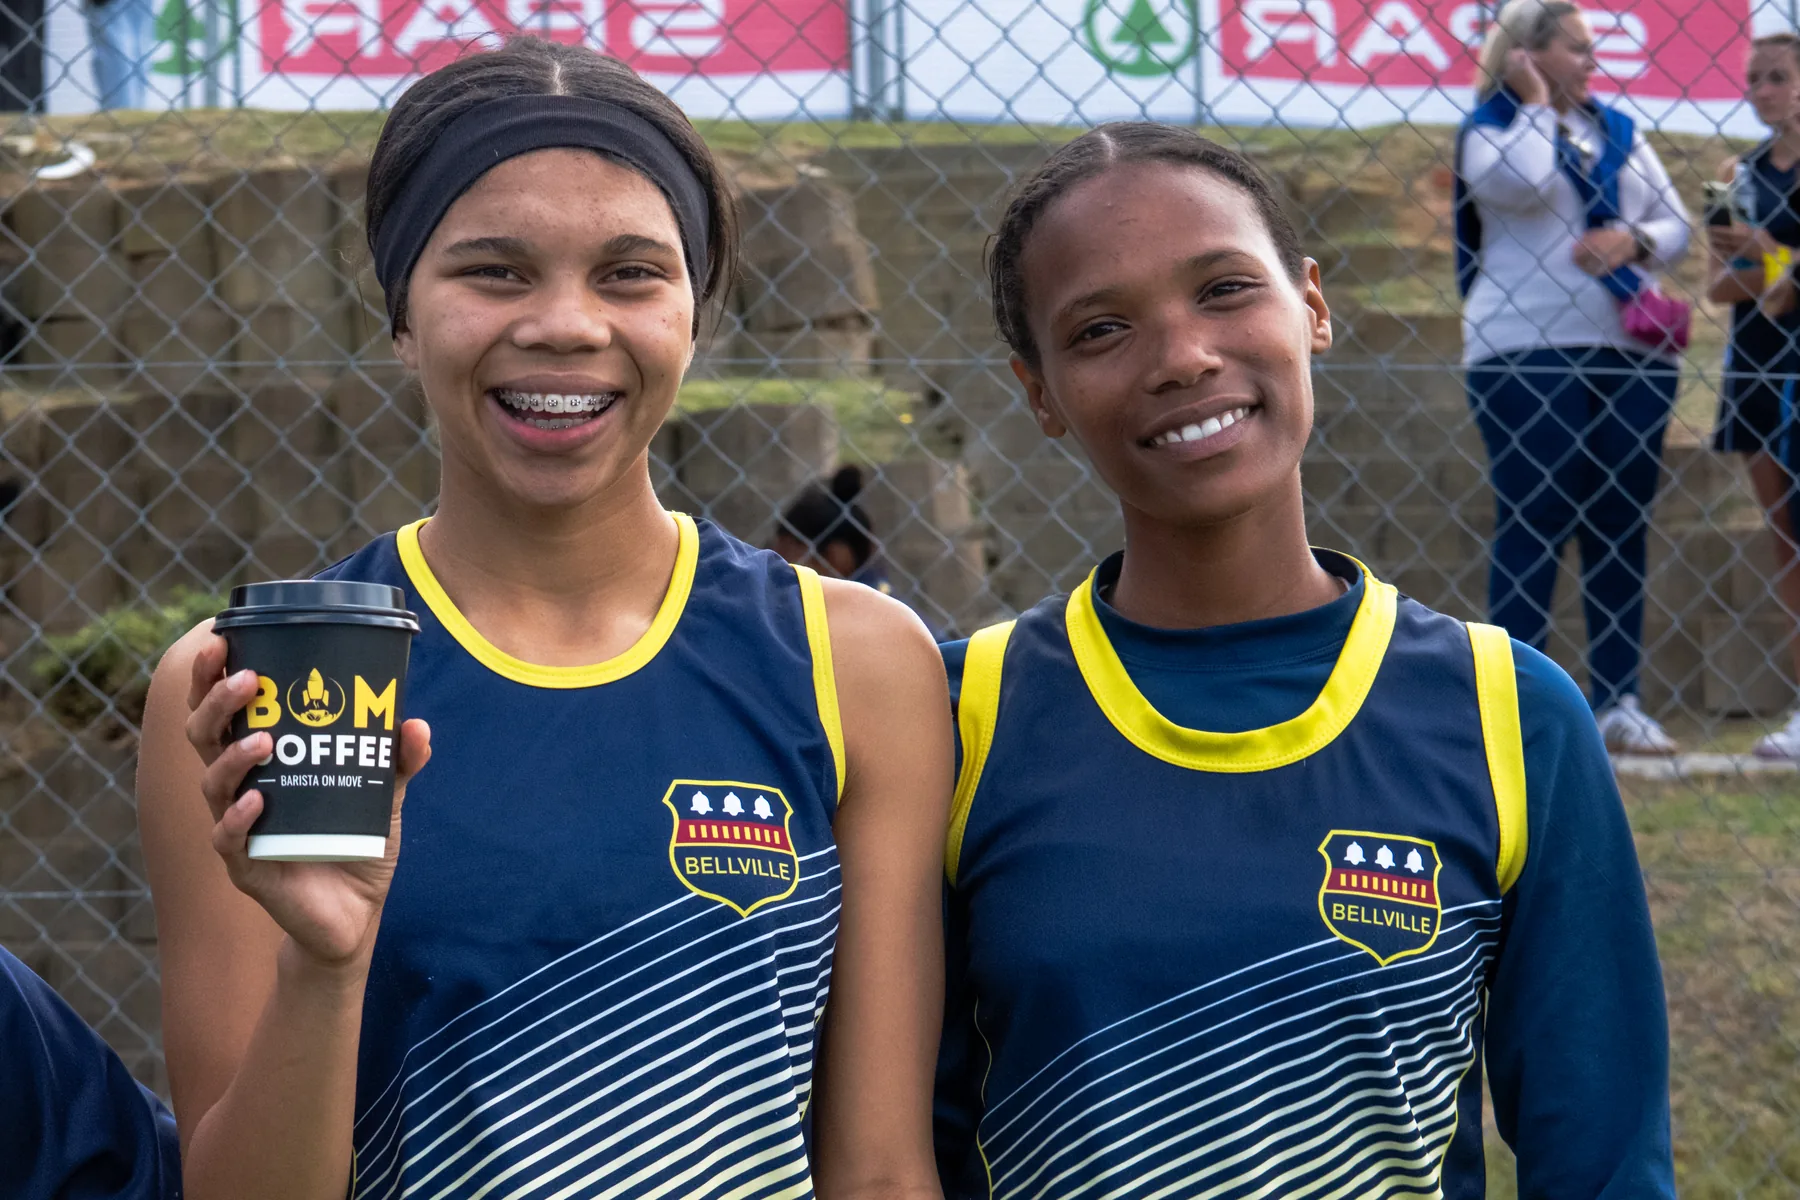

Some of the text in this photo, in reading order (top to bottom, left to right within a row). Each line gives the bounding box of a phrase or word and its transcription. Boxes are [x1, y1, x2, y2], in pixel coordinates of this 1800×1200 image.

[257, 733, 393, 768] OFFEE
[280, 774, 363, 788] BARISTA ON MOVE
[684, 856, 791, 881] BELLVILLE
[1332, 903, 1431, 935] BELLVILLE
